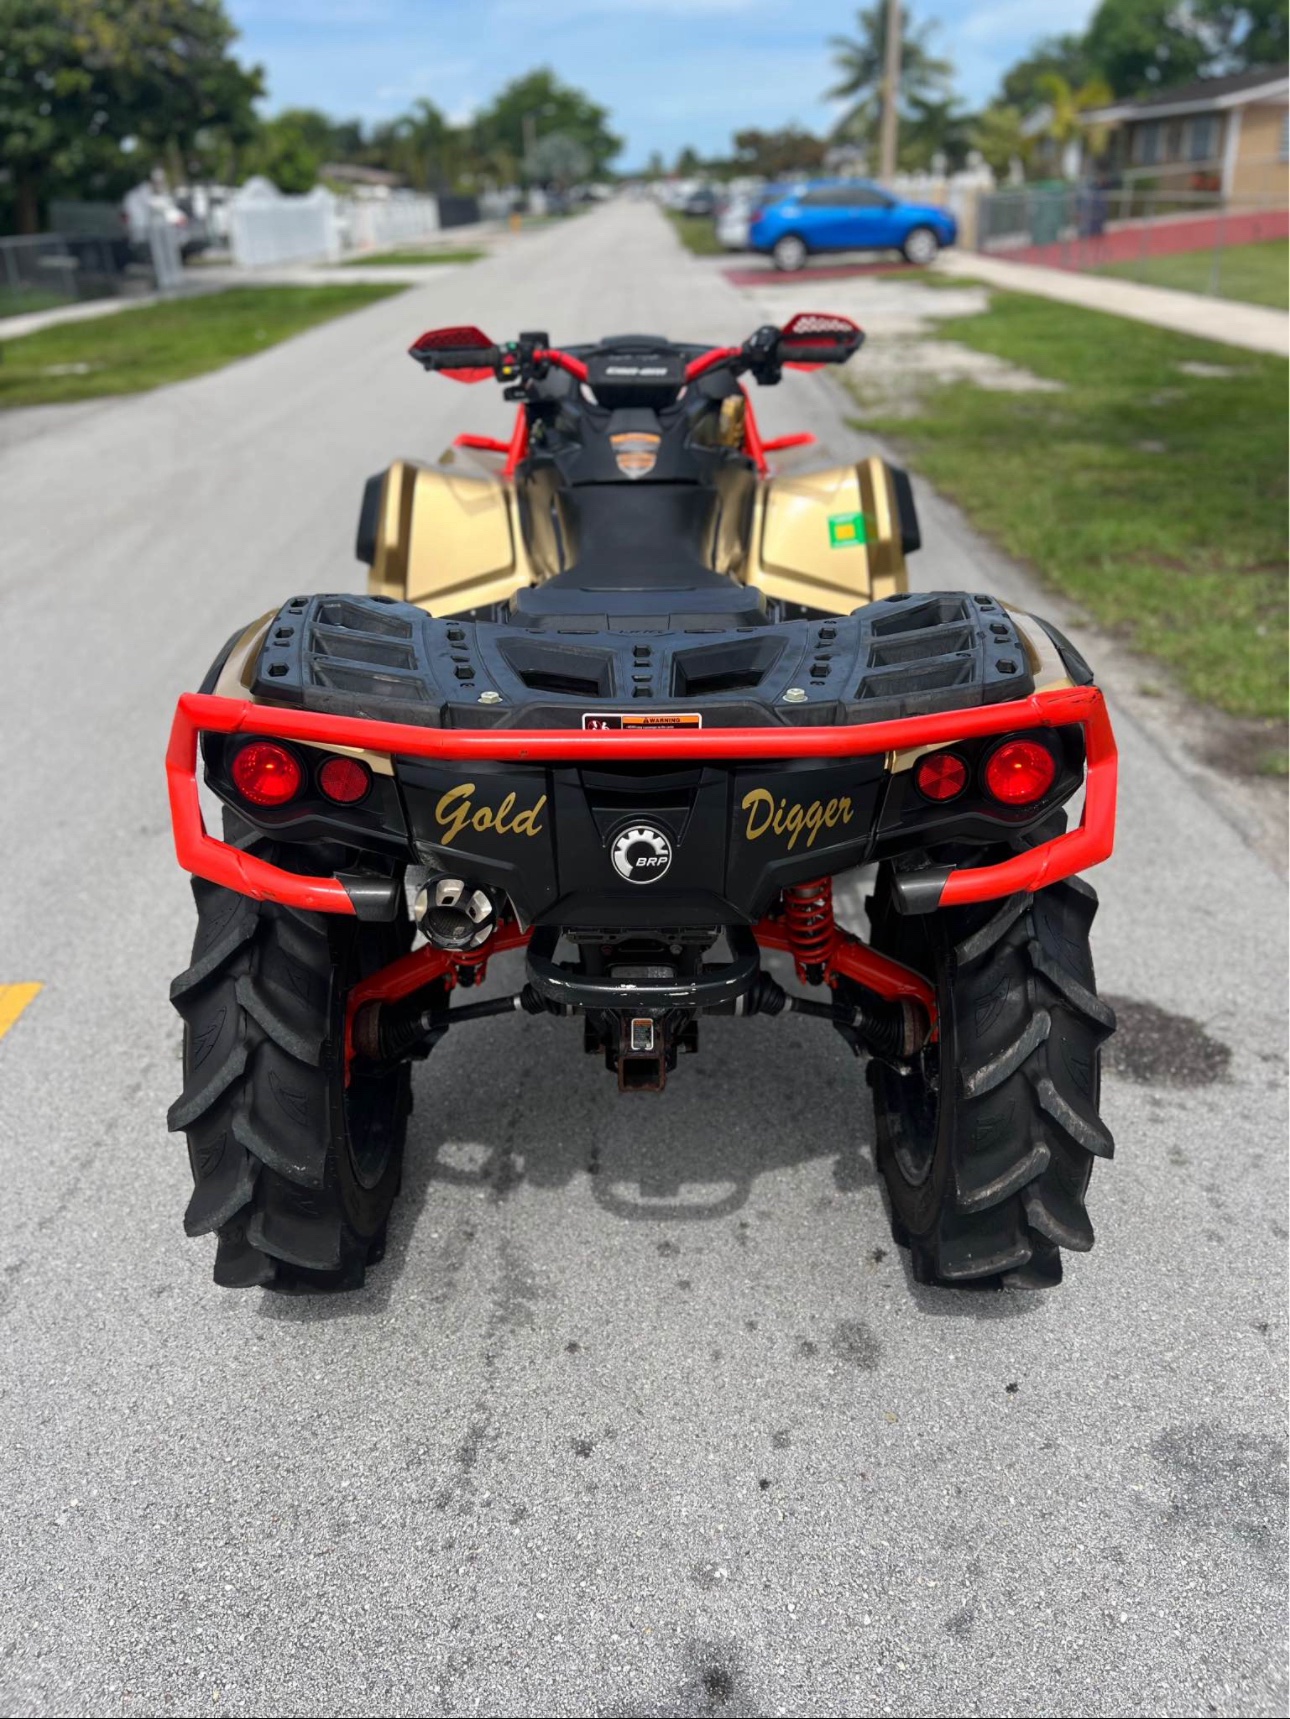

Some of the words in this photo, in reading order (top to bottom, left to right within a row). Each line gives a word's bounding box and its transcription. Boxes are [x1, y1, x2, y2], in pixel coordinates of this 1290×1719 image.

[435, 783, 547, 845] Gold
[742, 788, 854, 850] Digger
[636, 857, 668, 867] BRP
